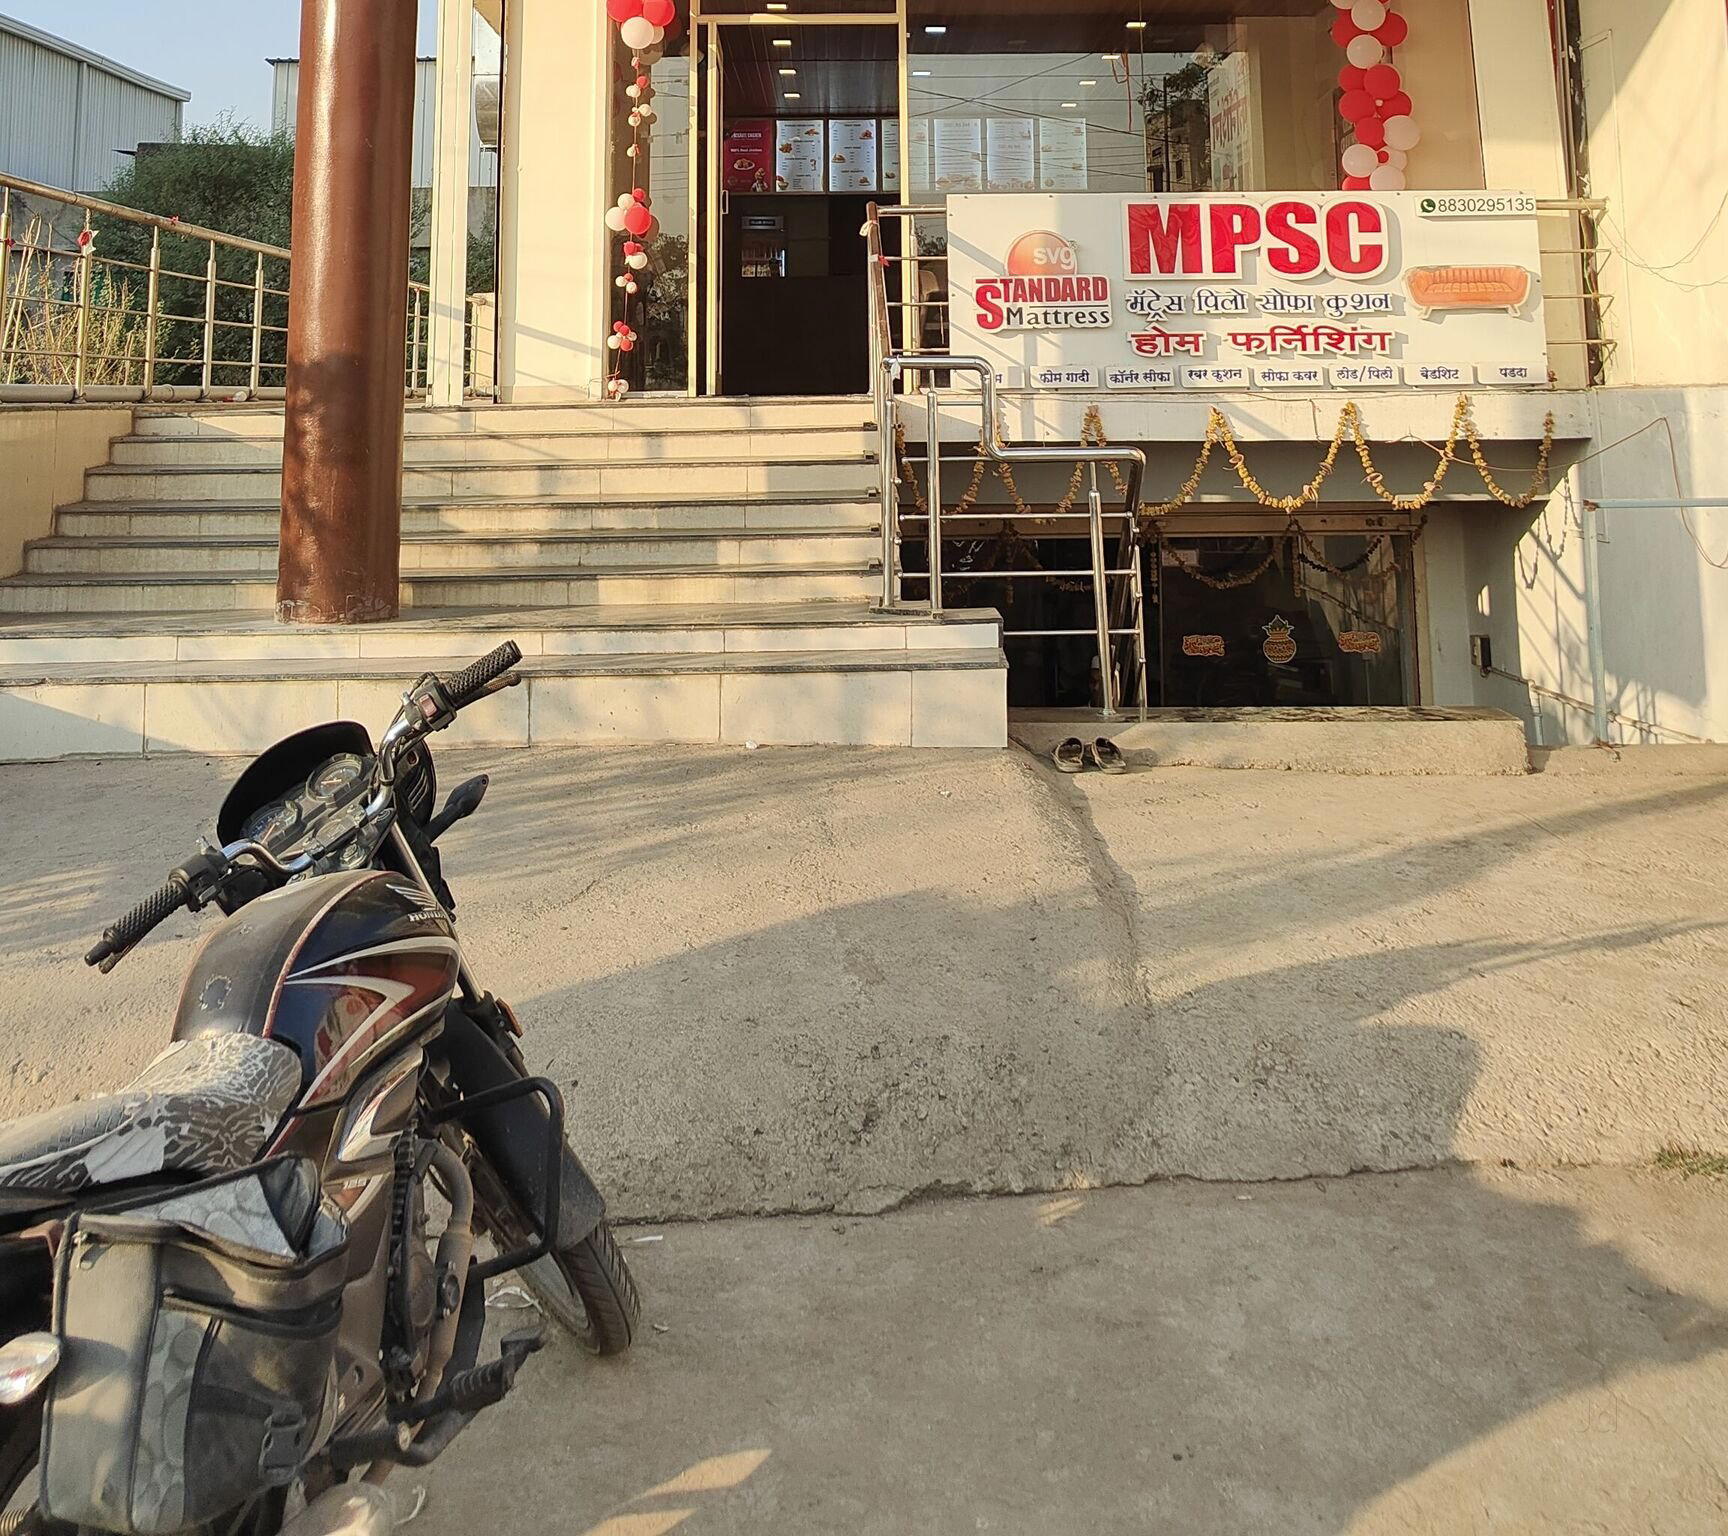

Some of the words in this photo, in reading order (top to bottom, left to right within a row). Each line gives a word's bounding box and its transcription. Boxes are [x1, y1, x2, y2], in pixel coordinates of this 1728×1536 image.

[1438, 198, 1534, 212] 8830295135
[1128, 201, 1383, 274] MPSC
[1033, 247, 1075, 270] svg
[976, 276, 1109, 330] STANDARD
[1196, 288, 1248, 311] पिलो
[1259, 288, 1314, 311] सोफा
[1325, 292, 1393, 315] कुशन
[1006, 306, 1110, 326] Mattress
[1130, 326, 1204, 354] होम
[1227, 325, 1393, 352] फर्निशिंग
[1065, 369, 1090, 383] गादी
[1499, 367, 1527, 378] पडदा
